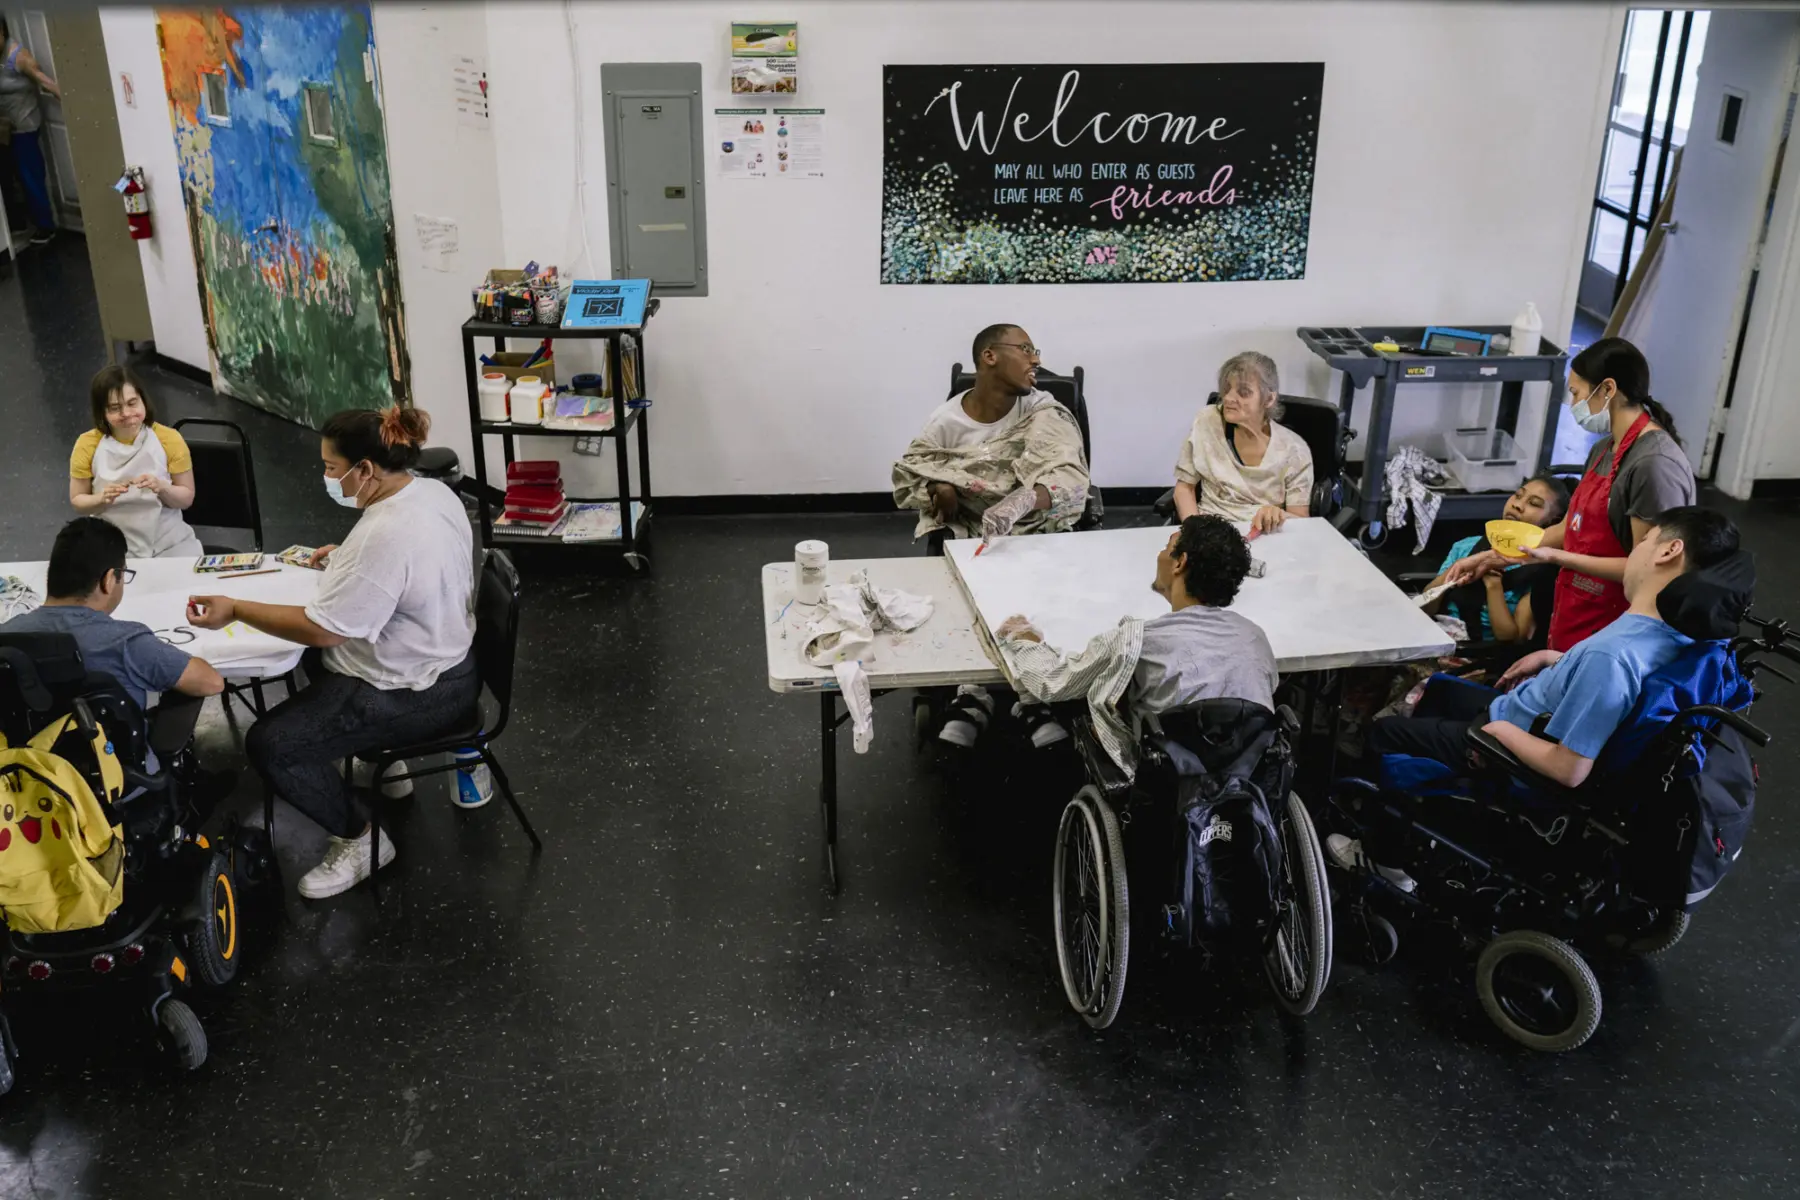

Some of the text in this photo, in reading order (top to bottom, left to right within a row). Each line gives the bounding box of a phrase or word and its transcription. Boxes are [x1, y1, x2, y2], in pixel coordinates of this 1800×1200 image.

[924, 70, 1245, 155] Welcome
[994, 163, 1195, 180] MAY ALL WHO ENTER AS GUESTS
[993, 164, 1244, 220] LEAVE HERE AS friends
[592, 301, 615, 314] XL
[1407, 367, 1425, 375] WEN
[1199, 824, 1232, 846] CLIPPERS
